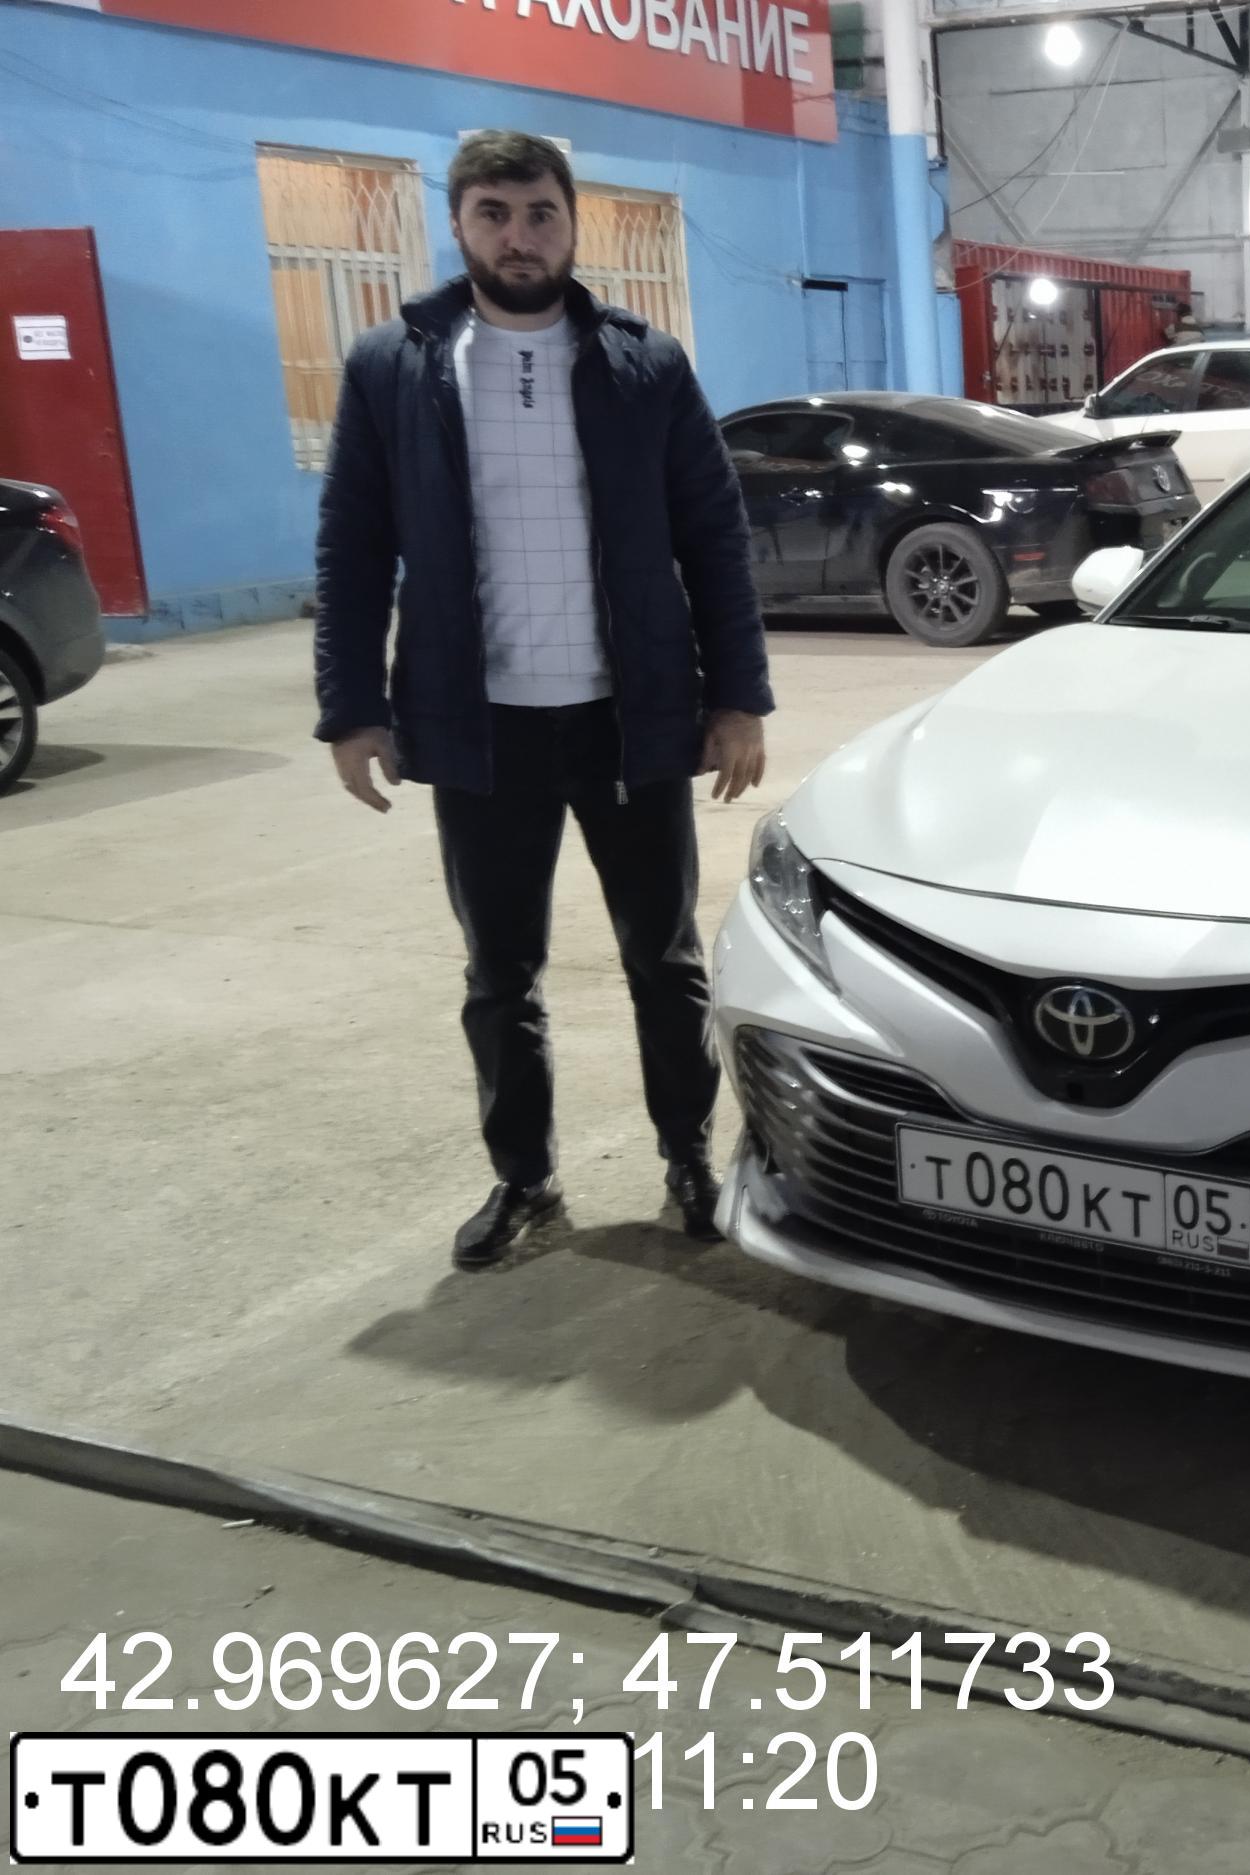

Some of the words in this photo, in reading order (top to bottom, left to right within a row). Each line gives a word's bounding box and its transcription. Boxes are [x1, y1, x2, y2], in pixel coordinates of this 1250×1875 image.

[455, 0, 814, 83] ОВАНИЕ
[925, 1151, 1151, 1238] Т080КТ
[1173, 1183, 1232, 1236] 05
[1172, 1230, 1215, 1253] RUS
